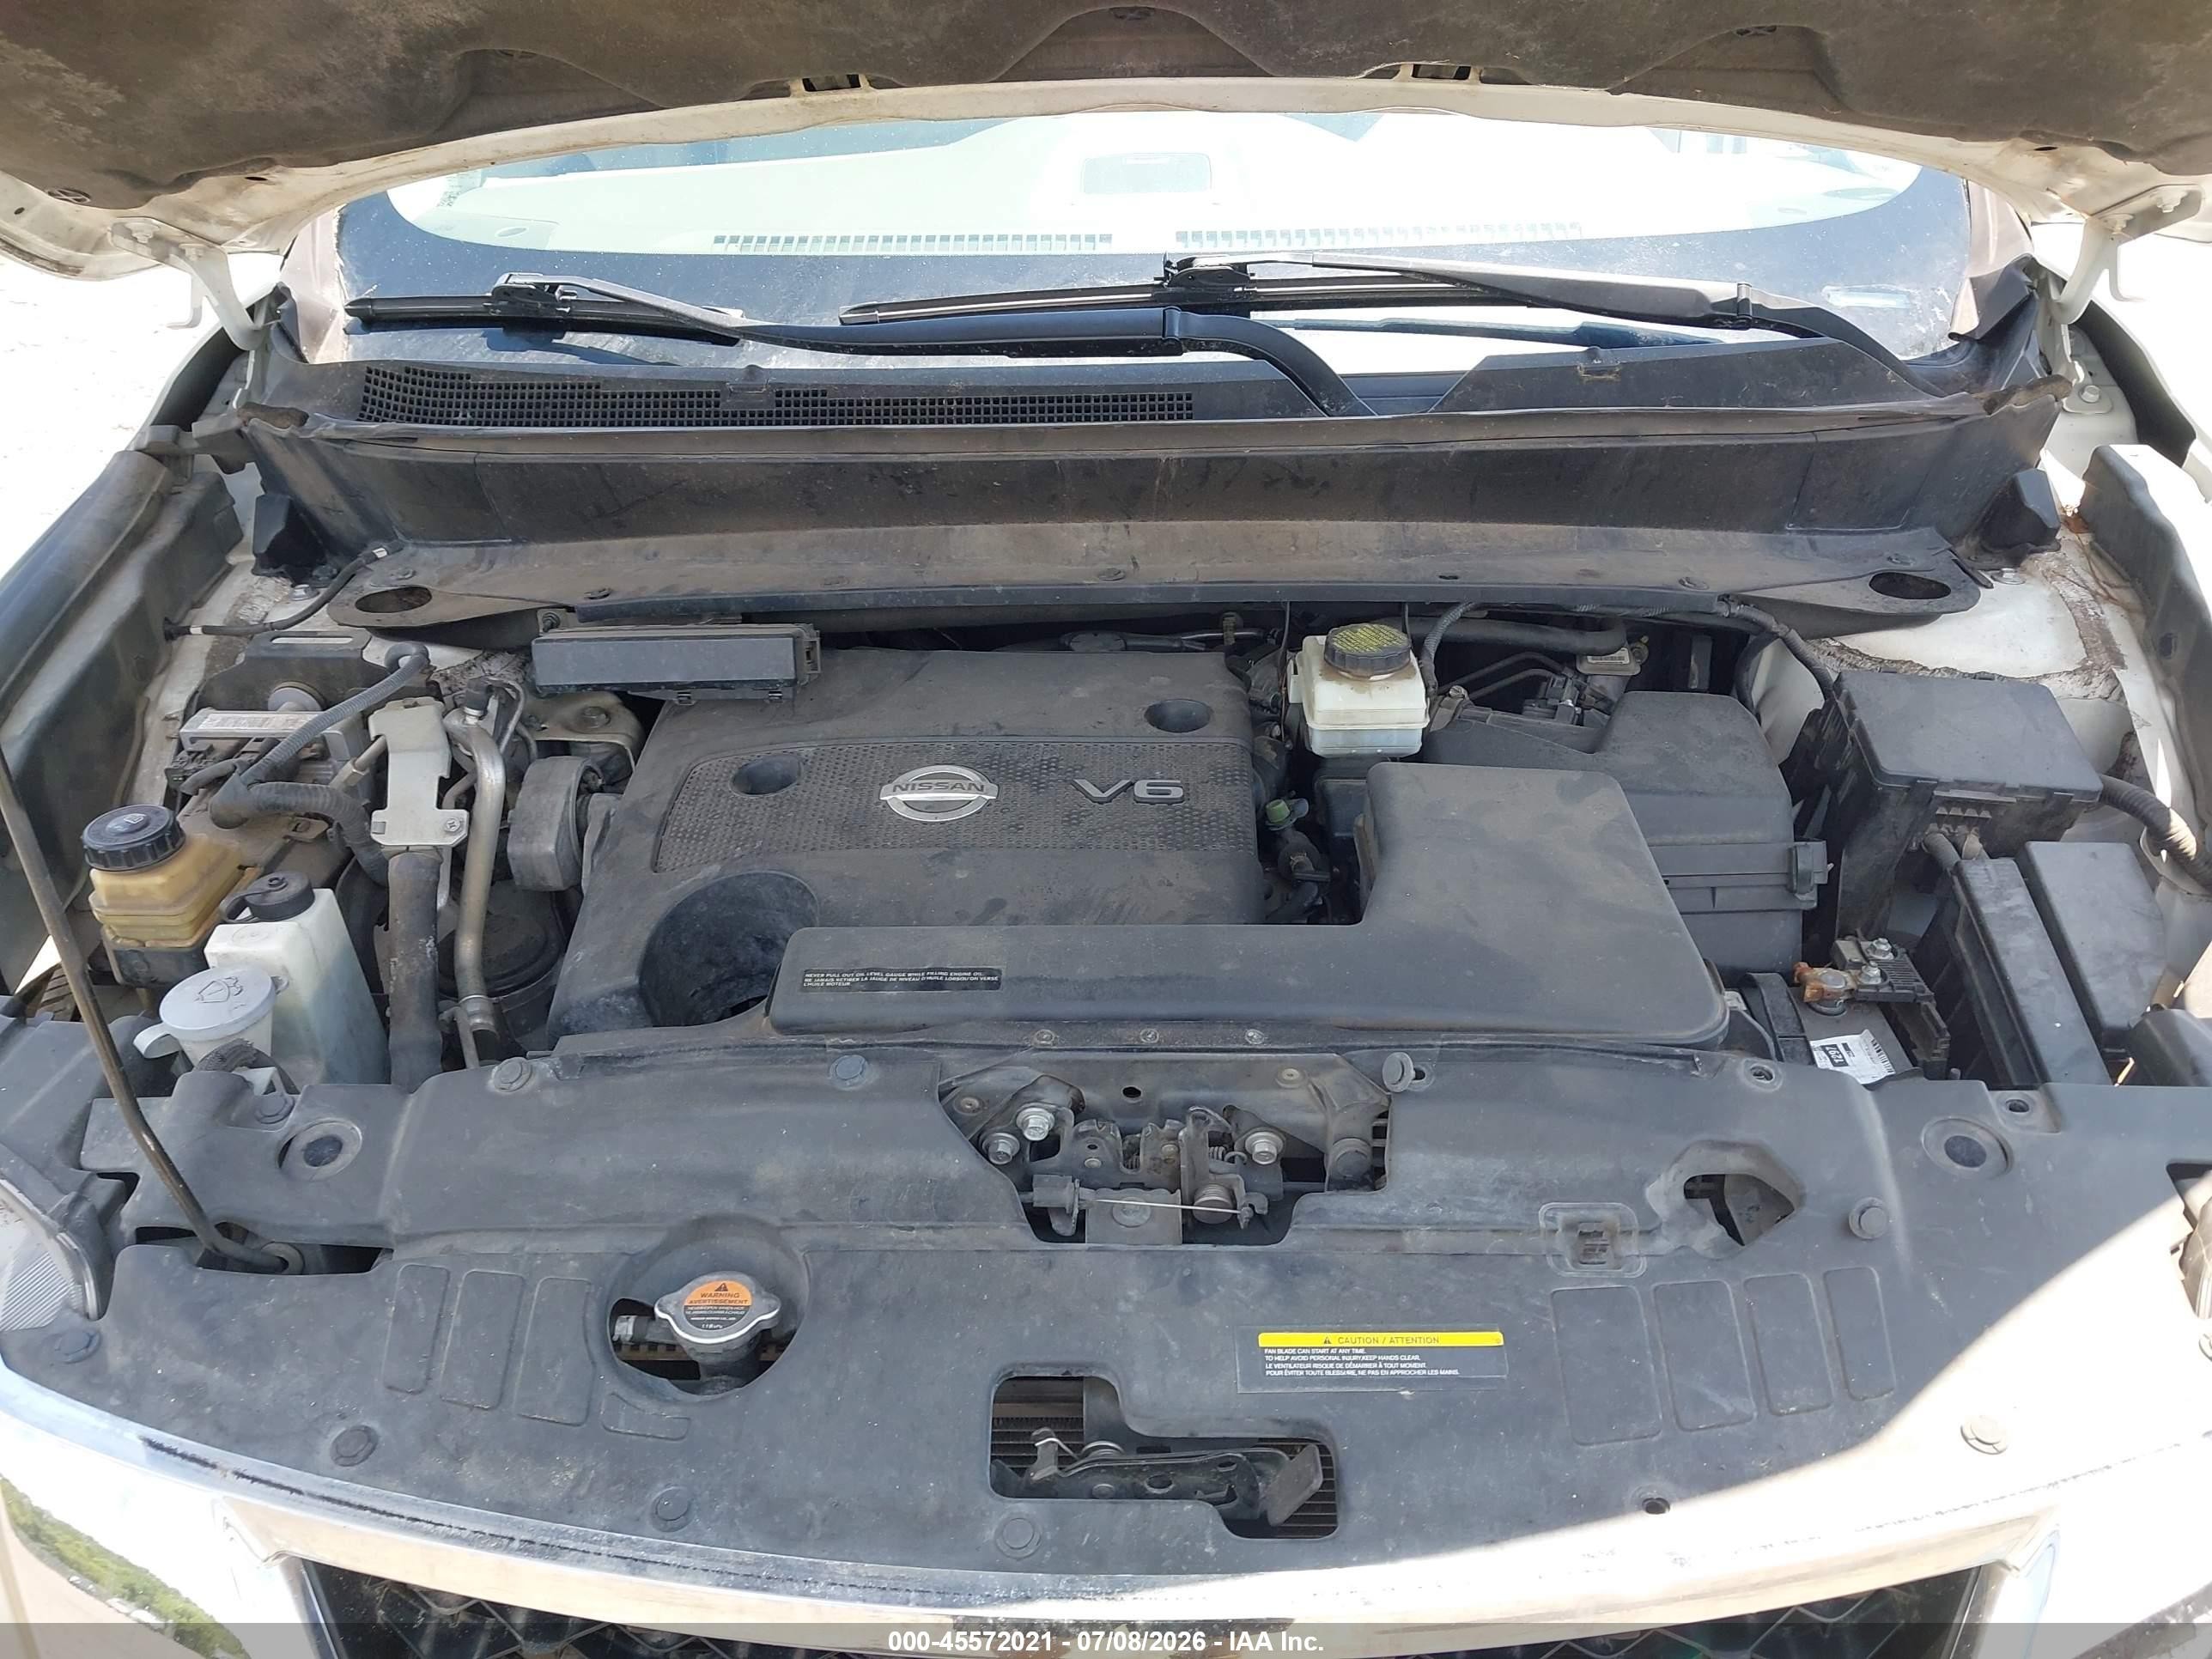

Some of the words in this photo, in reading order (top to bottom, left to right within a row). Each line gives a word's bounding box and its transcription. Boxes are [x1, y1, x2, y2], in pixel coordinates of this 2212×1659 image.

[893, 781, 985, 793] NISSAN
[1071, 778, 1186, 805] V6
[1338, 1336, 1379, 1345] CAUTION
[1389, 1336, 1439, 1345] ATTENTION
